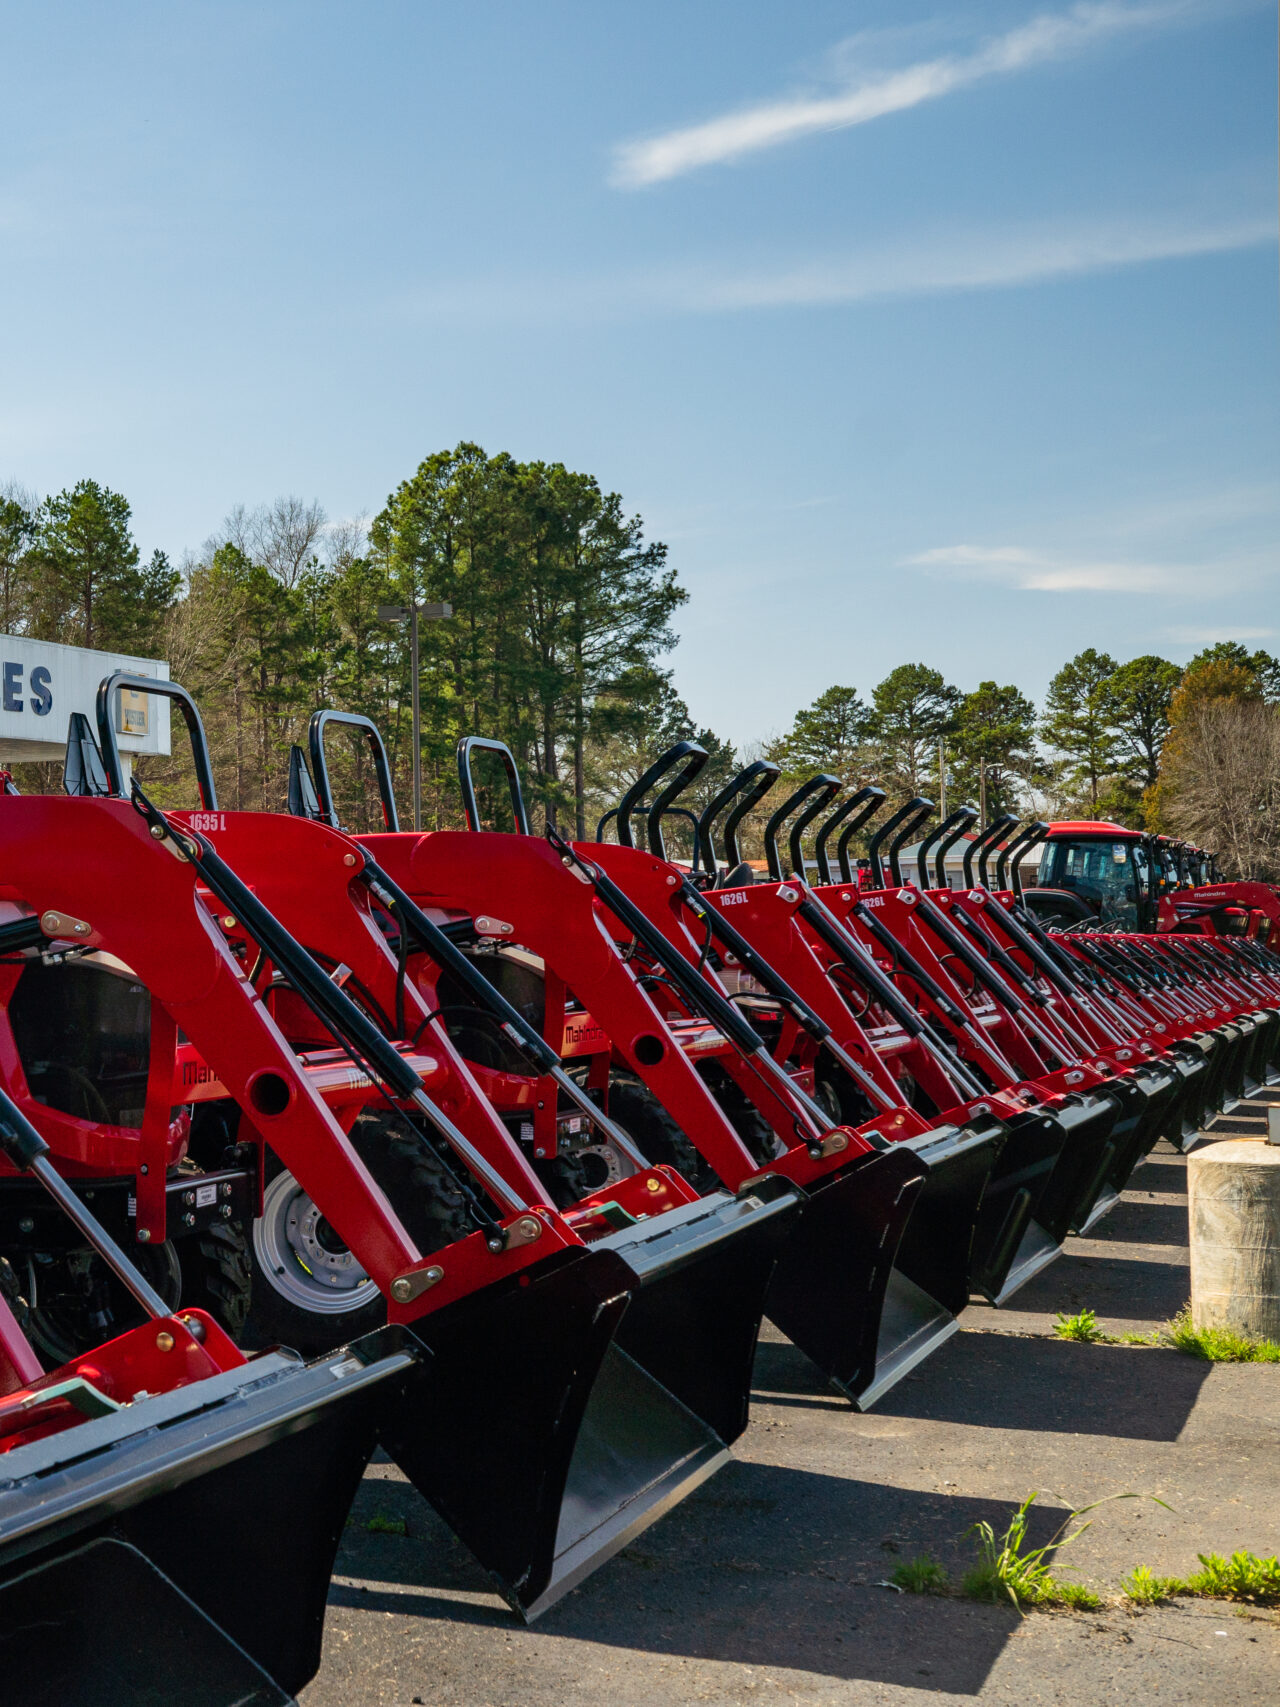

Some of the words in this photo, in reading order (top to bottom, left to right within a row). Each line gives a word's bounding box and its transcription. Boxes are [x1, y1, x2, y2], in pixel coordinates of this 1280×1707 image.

[189, 813, 218, 831] 1635
[220, 814, 226, 831] L
[720, 891, 748, 906] 1626L
